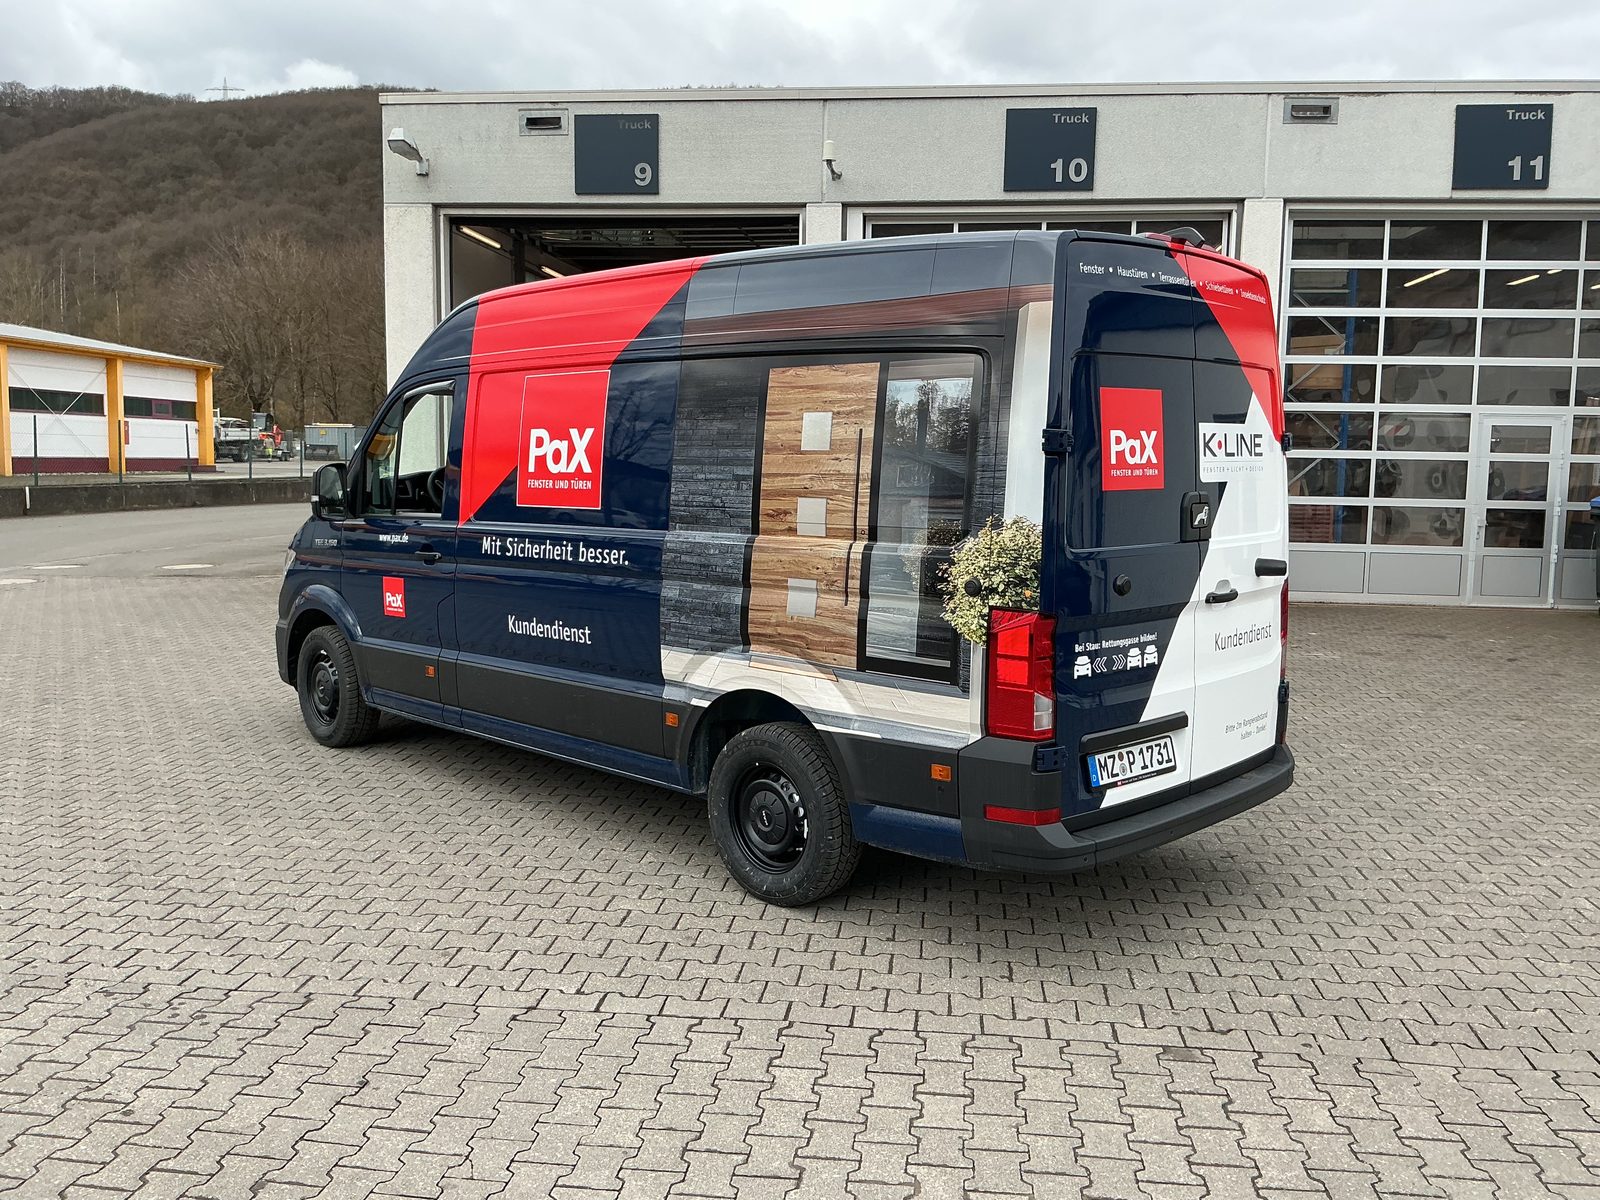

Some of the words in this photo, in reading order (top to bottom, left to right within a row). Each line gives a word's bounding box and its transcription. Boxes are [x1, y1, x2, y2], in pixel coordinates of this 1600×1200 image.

[1053, 113, 1089, 123] Truck
[1507, 109, 1546, 120] Truck
[617, 119, 651, 129] Truck
[634, 162, 652, 187] 9
[1050, 157, 1088, 183] 10
[1508, 155, 1544, 181] 11
[1079, 262, 1105, 275] Fenster
[1117, 266, 1149, 280] Haustüren
[528, 427, 595, 474] PaX
[1110, 429, 1158, 465] PaX
[1111, 469, 1132, 477] FENSTER
[1143, 467, 1158, 476] TÜREN
[527, 479, 553, 489] FENSTER
[555, 479, 569, 489] UND
[570, 477, 592, 490] TÜREN
[379, 533, 409, 544] www.pax.de
[482, 536, 501, 556] Mit
[506, 537, 573, 561] Sicherheit
[579, 542, 629, 566] besser.
[386, 592, 403, 607] PaX
[508, 614, 592, 645] Kundendienst
[1214, 621, 1272, 652] Kundendienst
[1075, 643, 1085, 653] Bei
[1086, 641, 1101, 652] Stau:
[1102, 636, 1139, 648] Rettungsgasse
[1098, 754, 1119, 780] MZ
[1126, 750, 1136, 773] P
[1138, 741, 1172, 770] 1731
[1092, 774, 1097, 782] D
